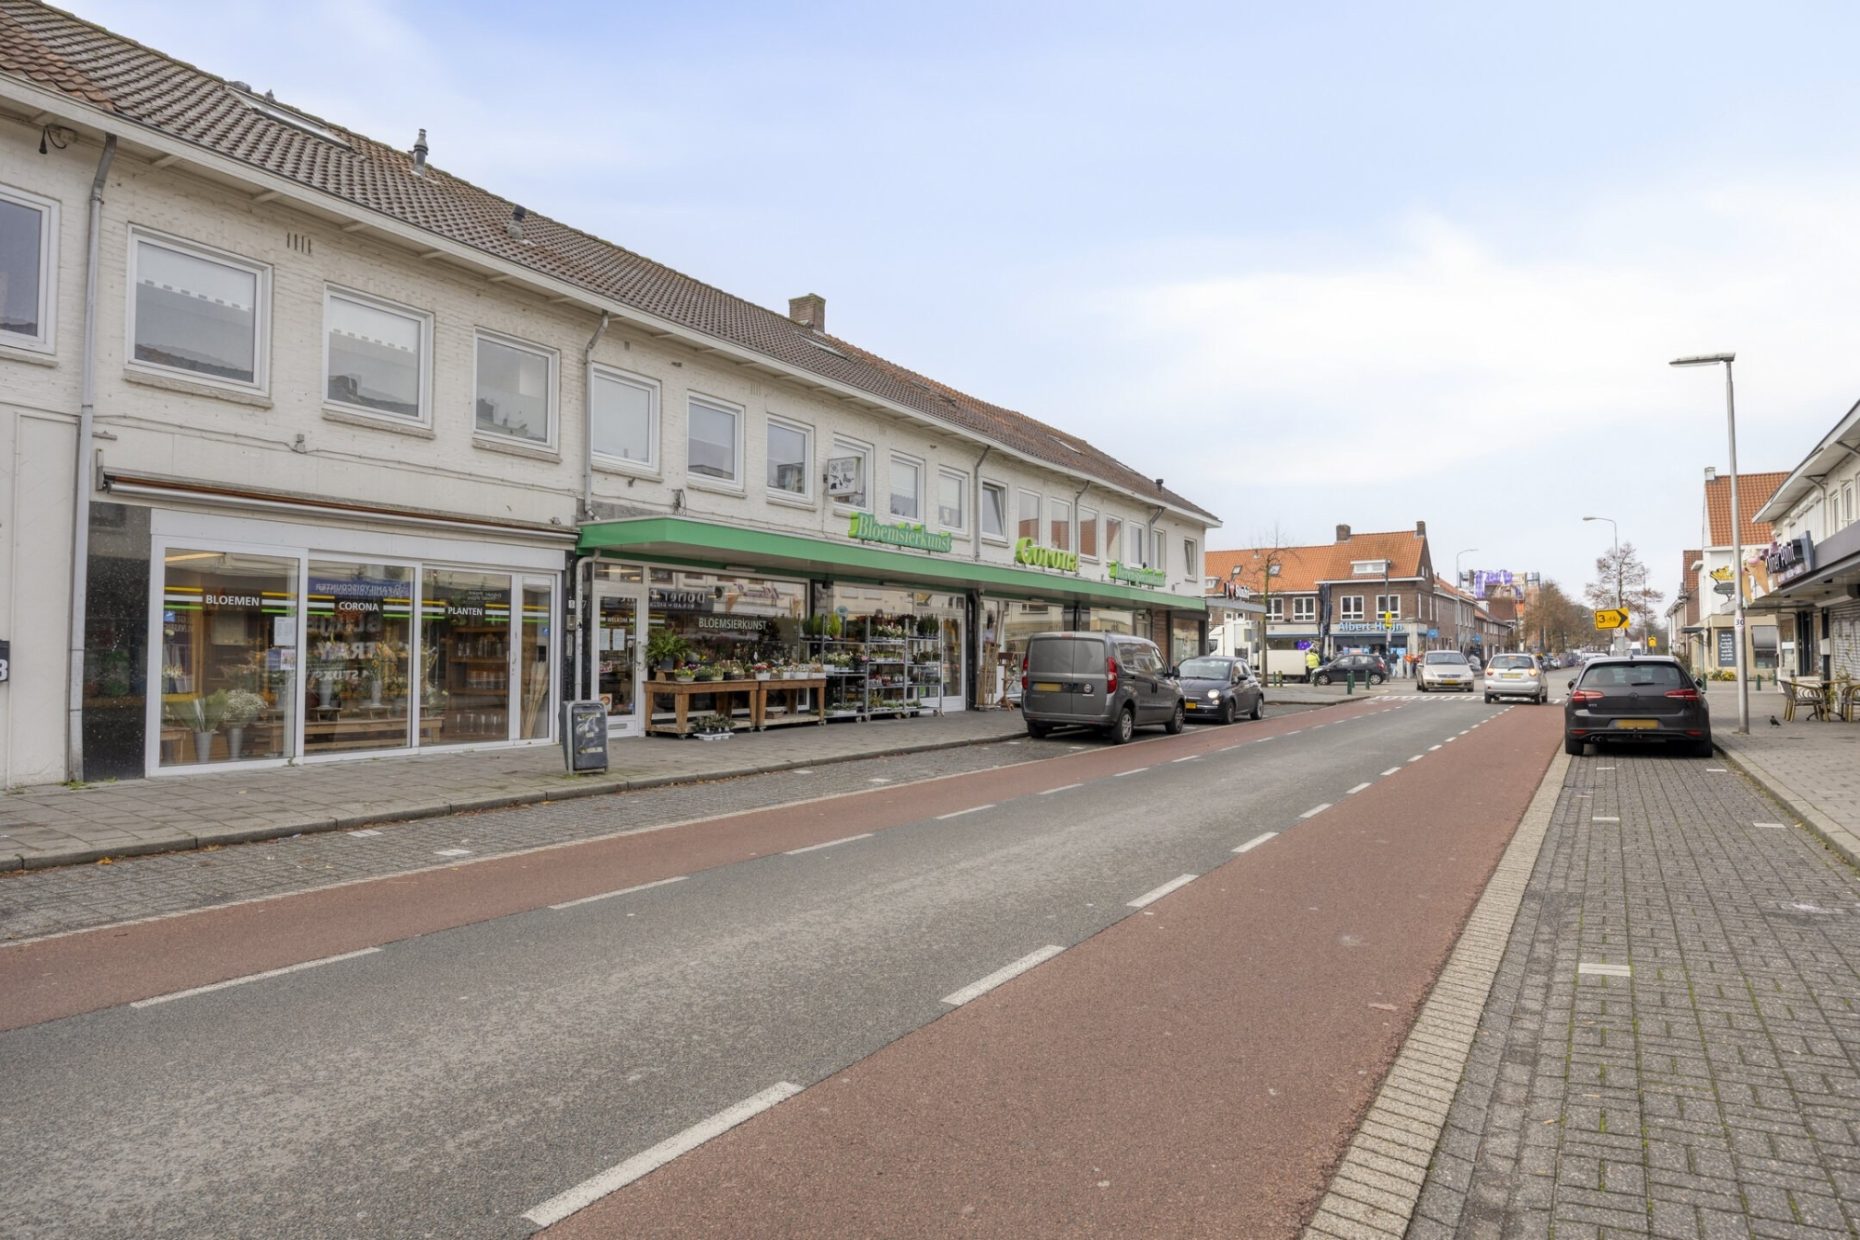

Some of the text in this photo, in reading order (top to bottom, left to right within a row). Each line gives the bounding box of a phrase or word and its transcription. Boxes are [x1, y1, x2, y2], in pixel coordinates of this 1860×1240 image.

[857, 512, 953, 553] Bloemsierkunst
[1015, 537, 1080, 573] Corona
[205, 594, 260, 607] BLOEMEN
[338, 601, 379, 612] CORONA
[447, 606, 483, 616] PLANTEN
[698, 617, 767, 631] BLOEMSIERKUNST
[1598, 614, 1606, 624] 3
[1338, 621, 1371, 632] Albert
